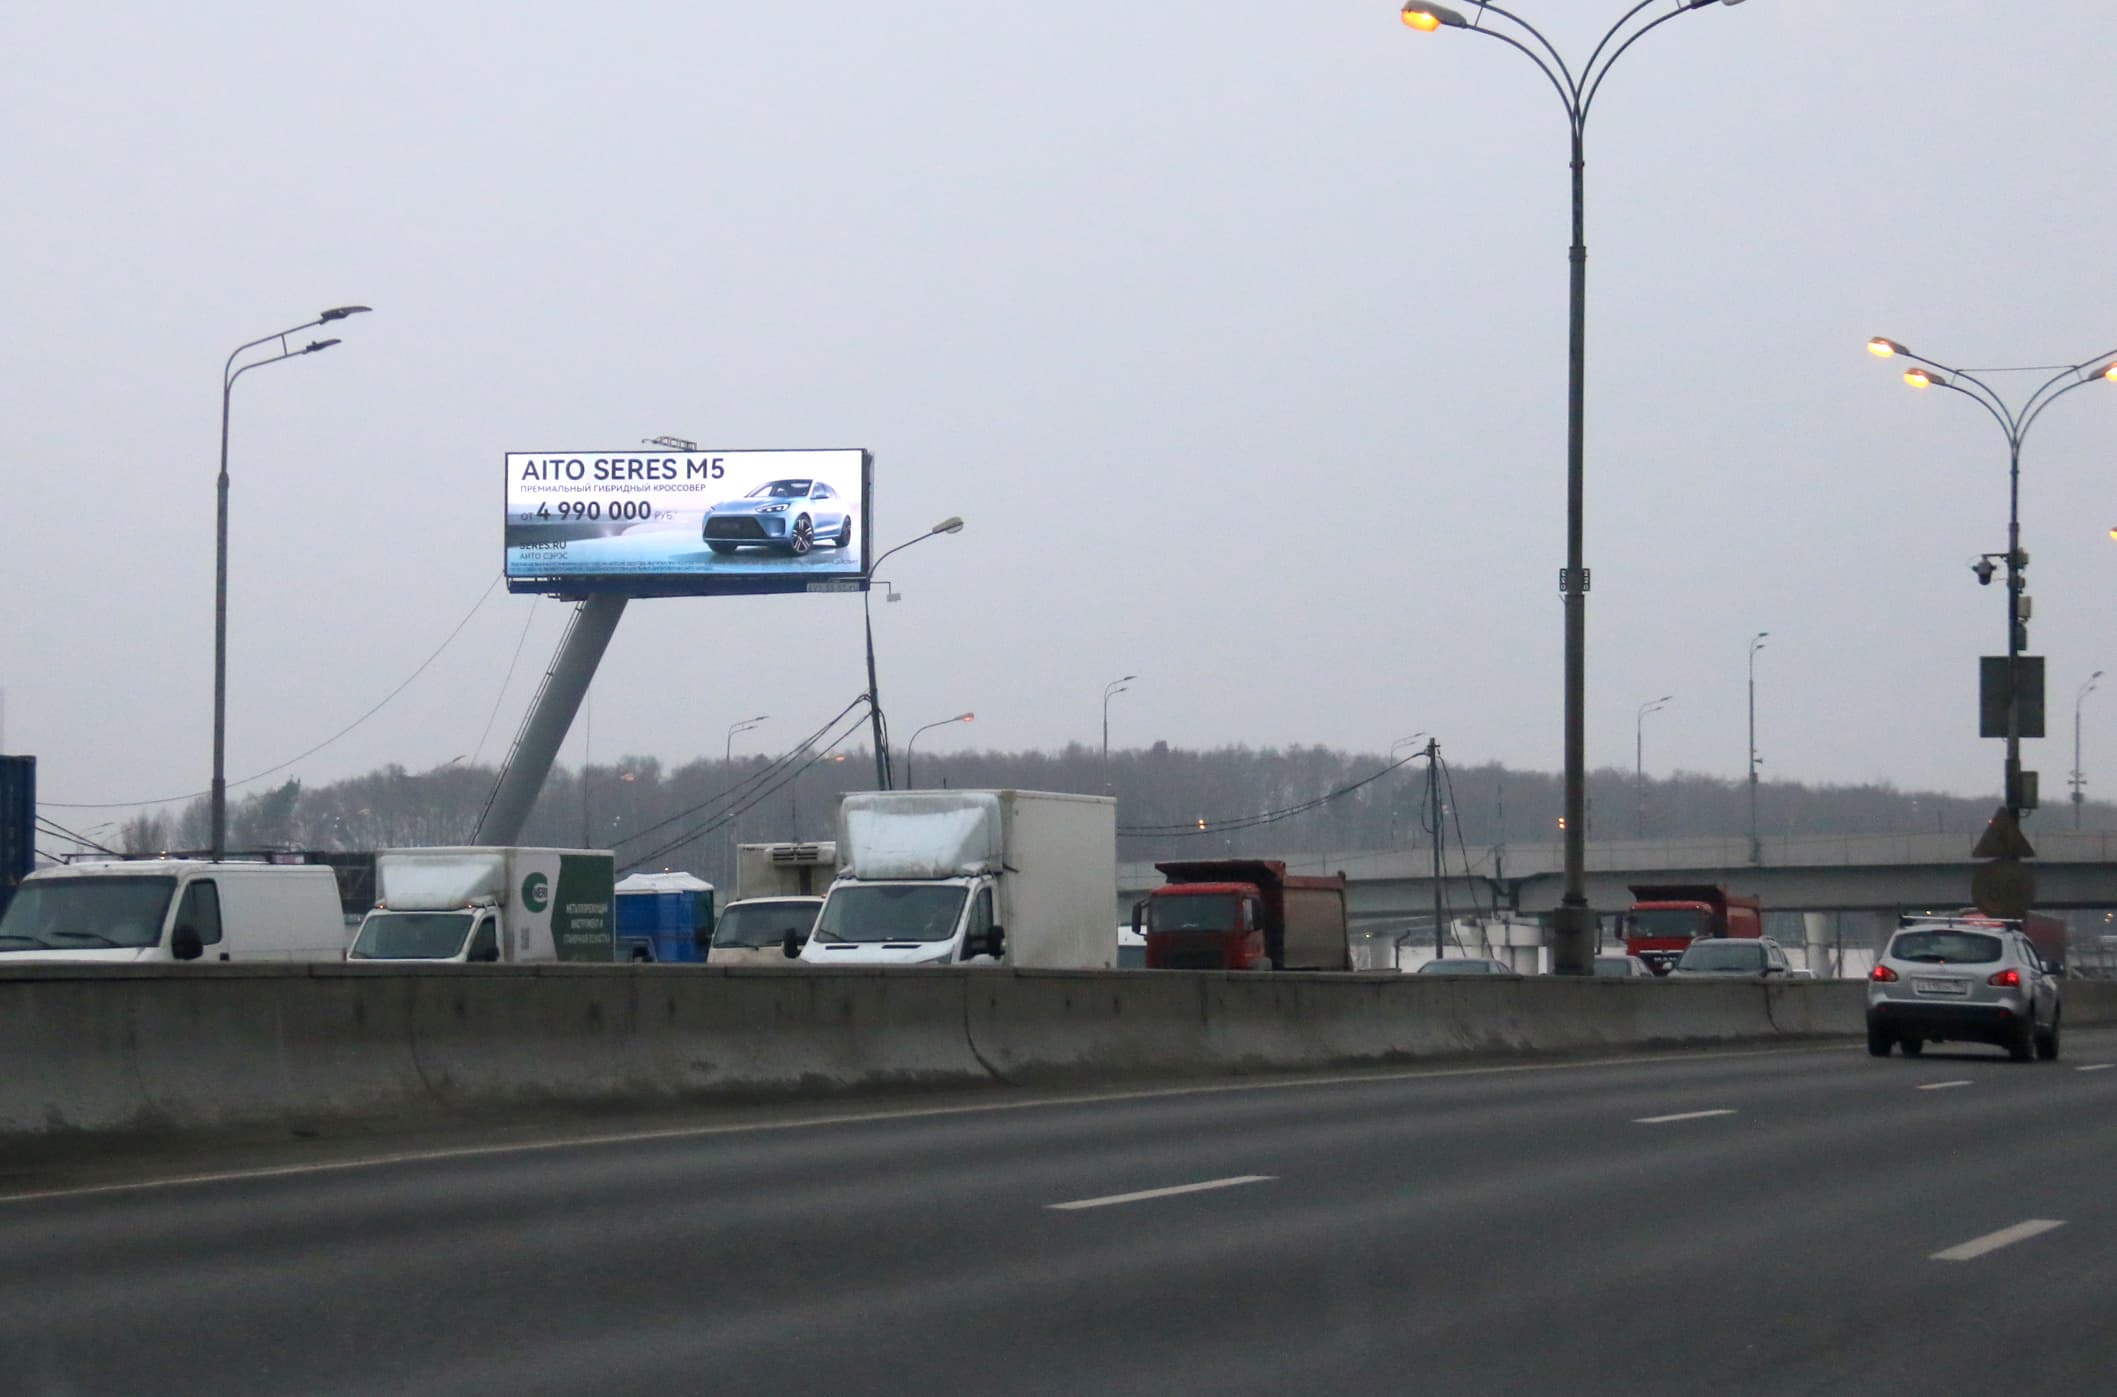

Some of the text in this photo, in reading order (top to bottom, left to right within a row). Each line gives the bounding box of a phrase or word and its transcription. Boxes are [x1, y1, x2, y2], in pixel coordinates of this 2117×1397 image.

[521, 458, 725, 481] AITO SERES M5
[520, 483, 706, 494] ПРЕМИАЛЬНЫЙ ГИБРИДНЫЙ КРОССОВЕР
[536, 501, 550, 521] 4
[558, 501, 600, 521] 990
[609, 500, 652, 521] 000
